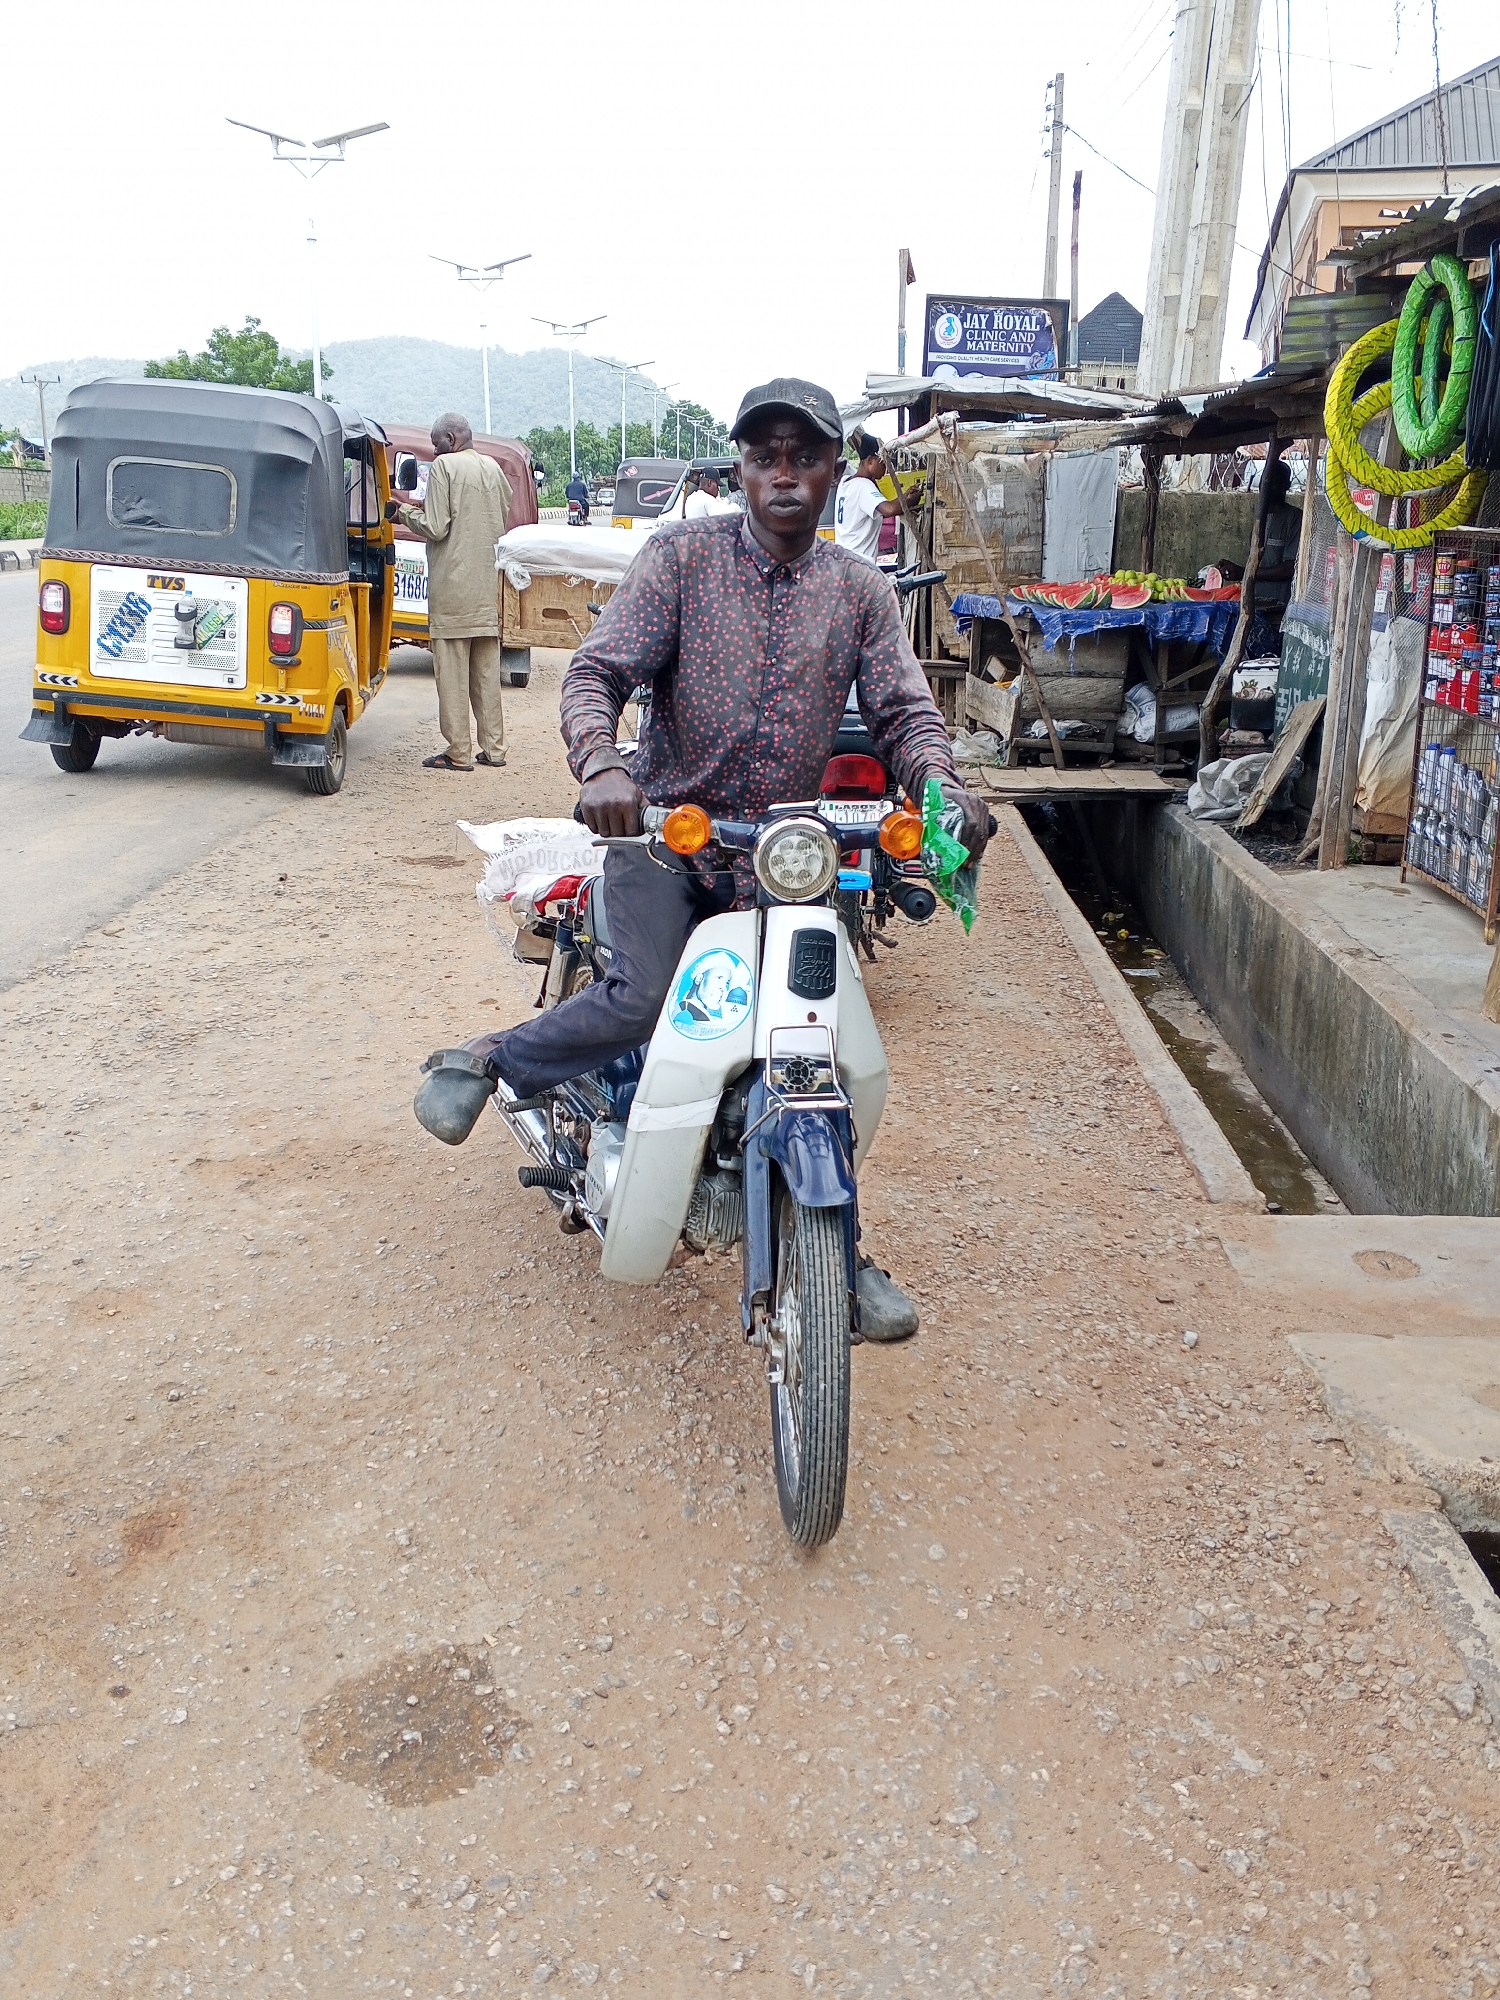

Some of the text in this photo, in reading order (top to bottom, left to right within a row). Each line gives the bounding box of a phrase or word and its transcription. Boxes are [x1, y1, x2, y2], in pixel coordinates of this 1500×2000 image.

[963, 313, 1040, 332] JAY ROYAL
[966, 330, 1036, 343] CLINIC AND
[966, 341, 1034, 353] MATERNITY
[148, 576, 185, 591] TVS
[600, 946, 612, 960] HON
